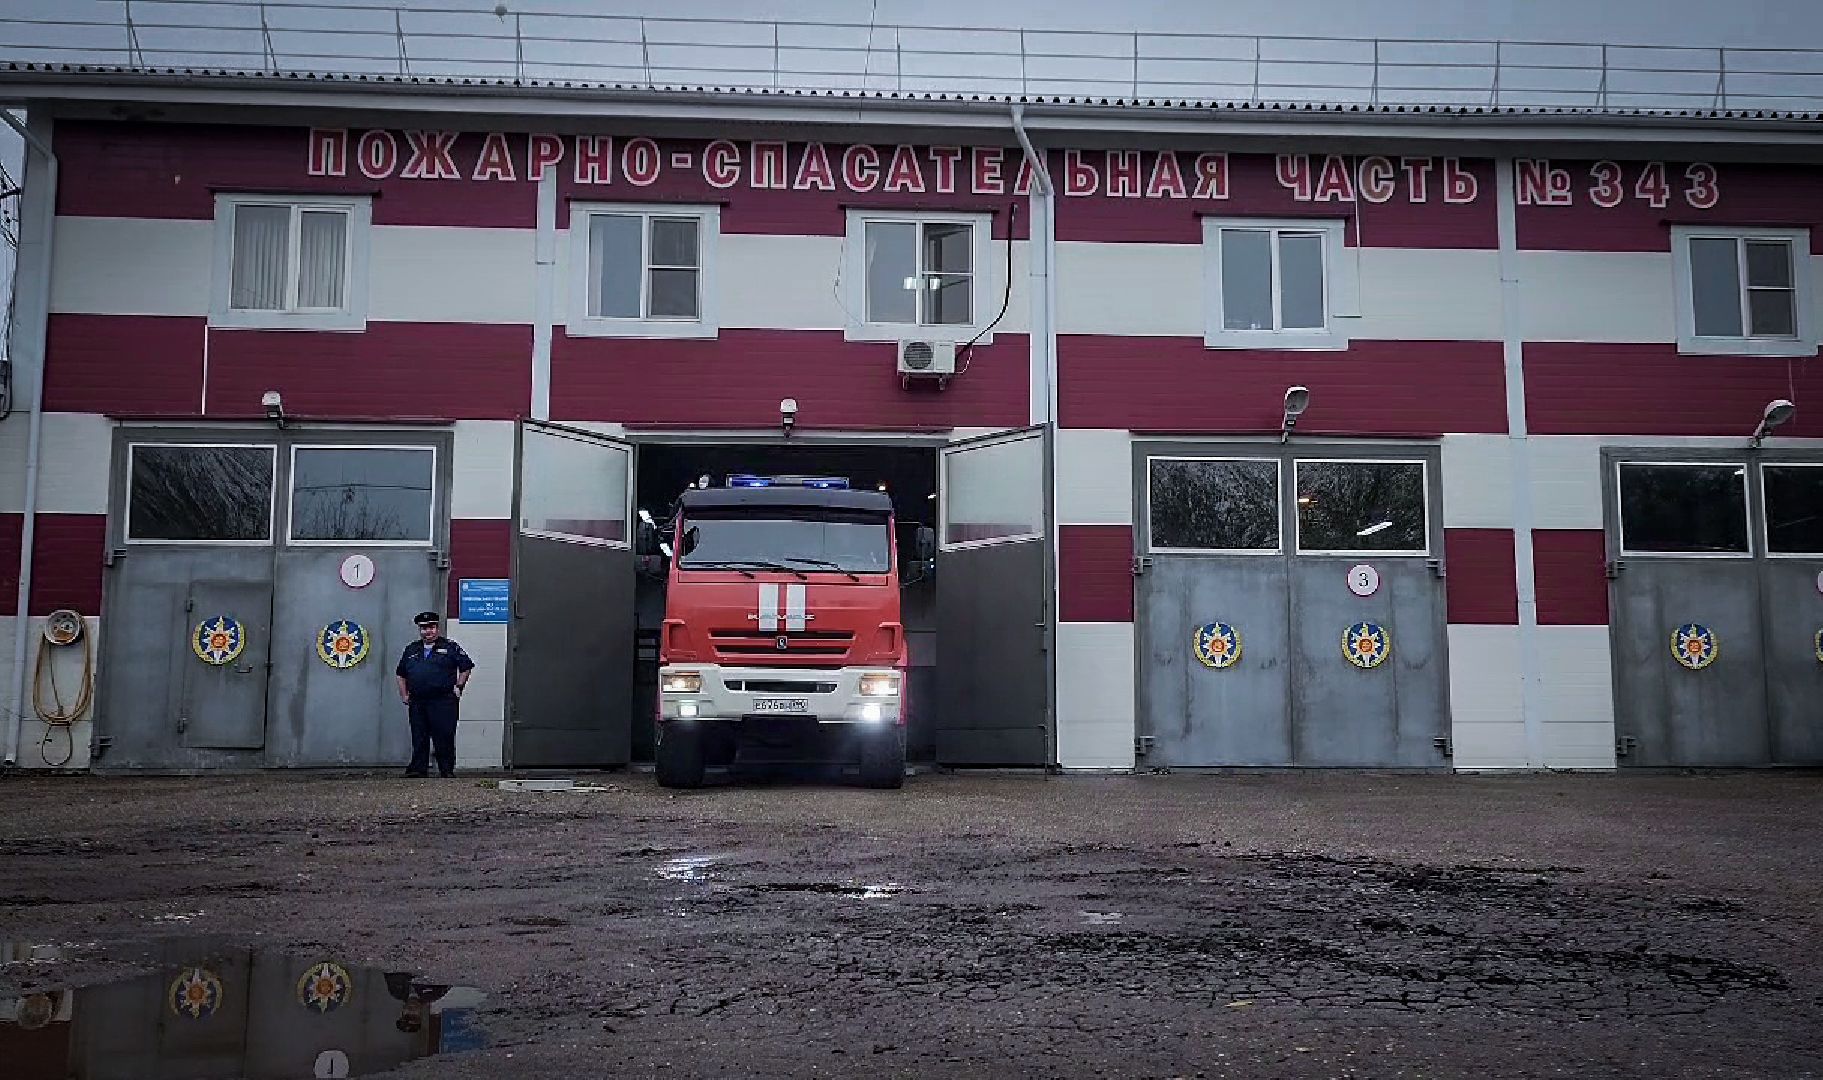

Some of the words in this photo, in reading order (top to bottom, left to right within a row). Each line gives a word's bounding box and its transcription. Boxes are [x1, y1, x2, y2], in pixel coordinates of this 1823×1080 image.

[1276, 154, 1478, 203] ЧАСТЬ
[353, 563, 361, 579] 1
[1359, 572, 1369, 587] 3
